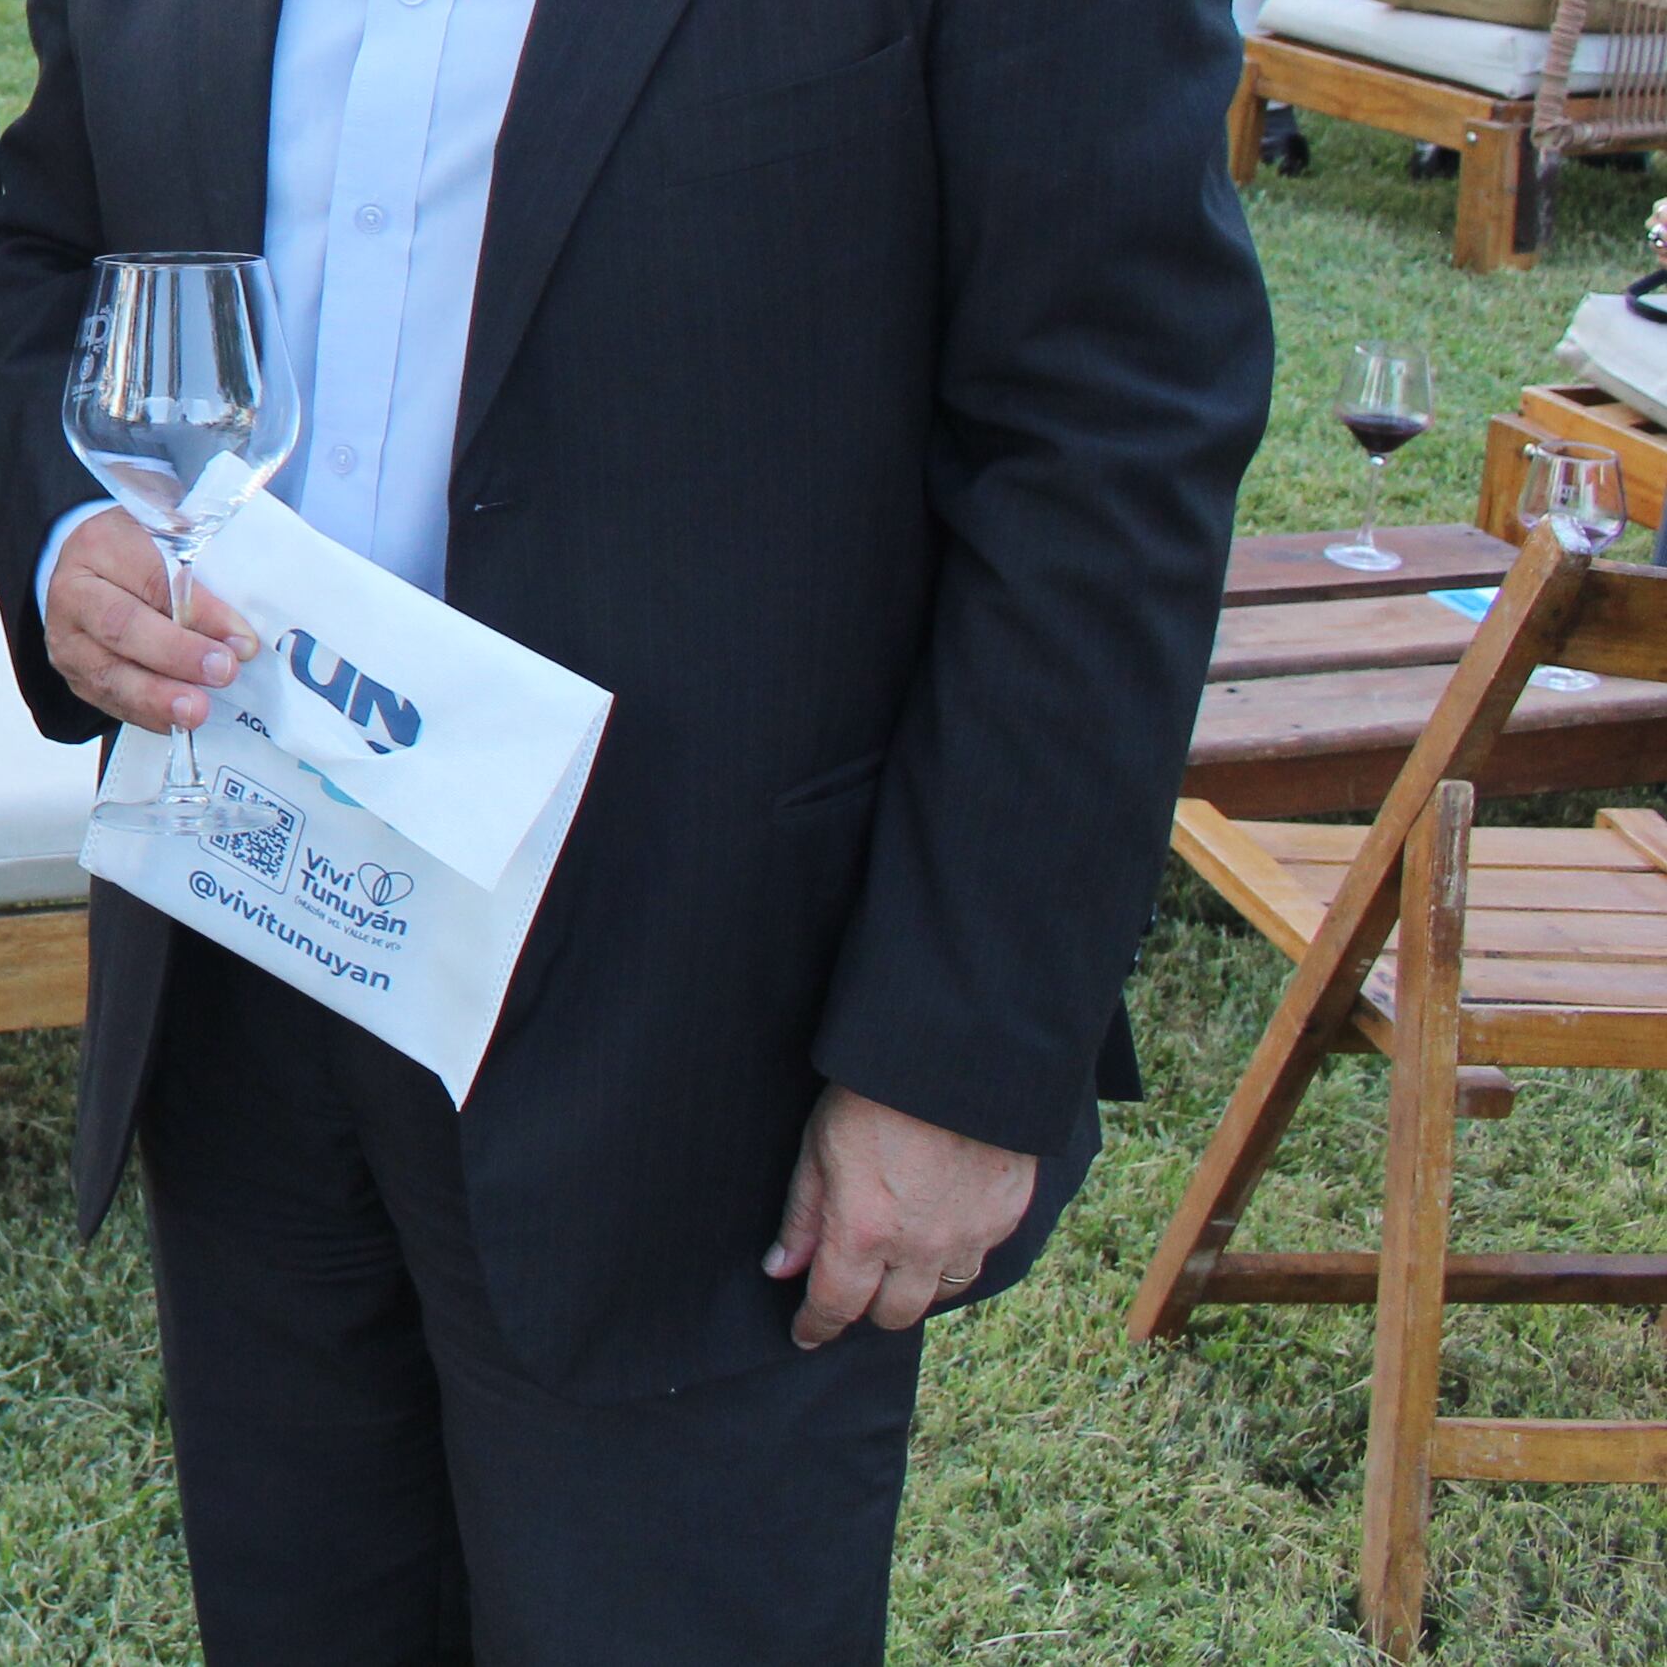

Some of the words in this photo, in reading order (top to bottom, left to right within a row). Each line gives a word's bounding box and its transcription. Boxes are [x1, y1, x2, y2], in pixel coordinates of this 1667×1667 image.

[306, 846, 355, 892] Viví
[300, 868, 408, 936] Tunuyán
[188, 870, 392, 992] @vivitunuyan
[343, 925, 369, 944] VALLE
